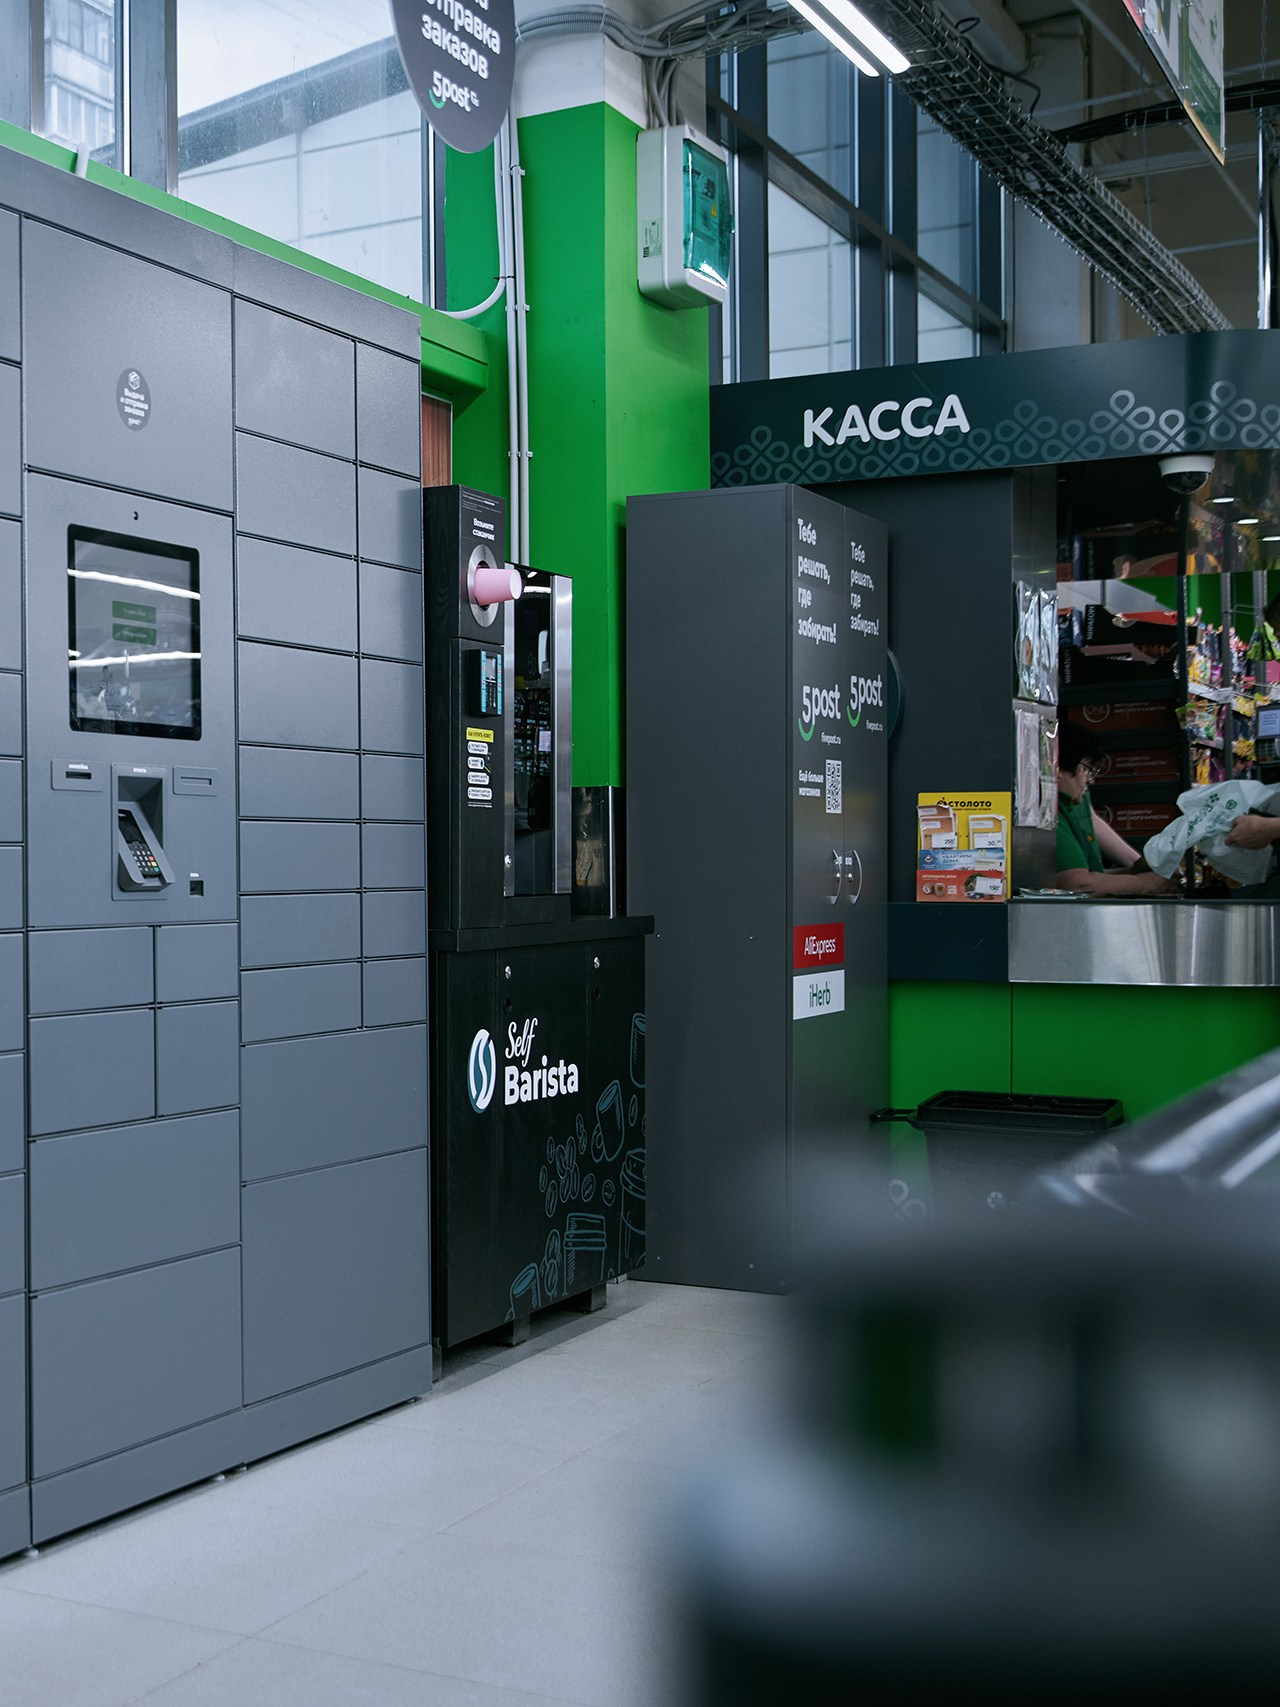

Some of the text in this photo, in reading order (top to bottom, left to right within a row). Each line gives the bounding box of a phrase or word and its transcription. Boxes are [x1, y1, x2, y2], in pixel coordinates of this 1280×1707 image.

[426, 0, 500, 54] правка
[421, 14, 489, 79] заказов
[432, 70, 471, 112] 5post
[803, 394, 970, 448] КАССА
[797, 518, 817, 545] Тебе
[850, 541, 865, 564] Тебе
[798, 555, 831, 585] решать,
[850, 569, 875, 592] решать,
[798, 587, 812, 608] где
[850, 592, 862, 611] где
[797, 617, 837, 644] забирать!
[850, 614, 879, 637] забирать!
[802, 684, 841, 725] 5post
[849, 674, 883, 712] 5post
[804, 936, 836, 960] AliExpress
[809, 981, 832, 1008] iHerb
[504, 1016, 538, 1068] Self
[504, 1054, 579, 1106] Barista
